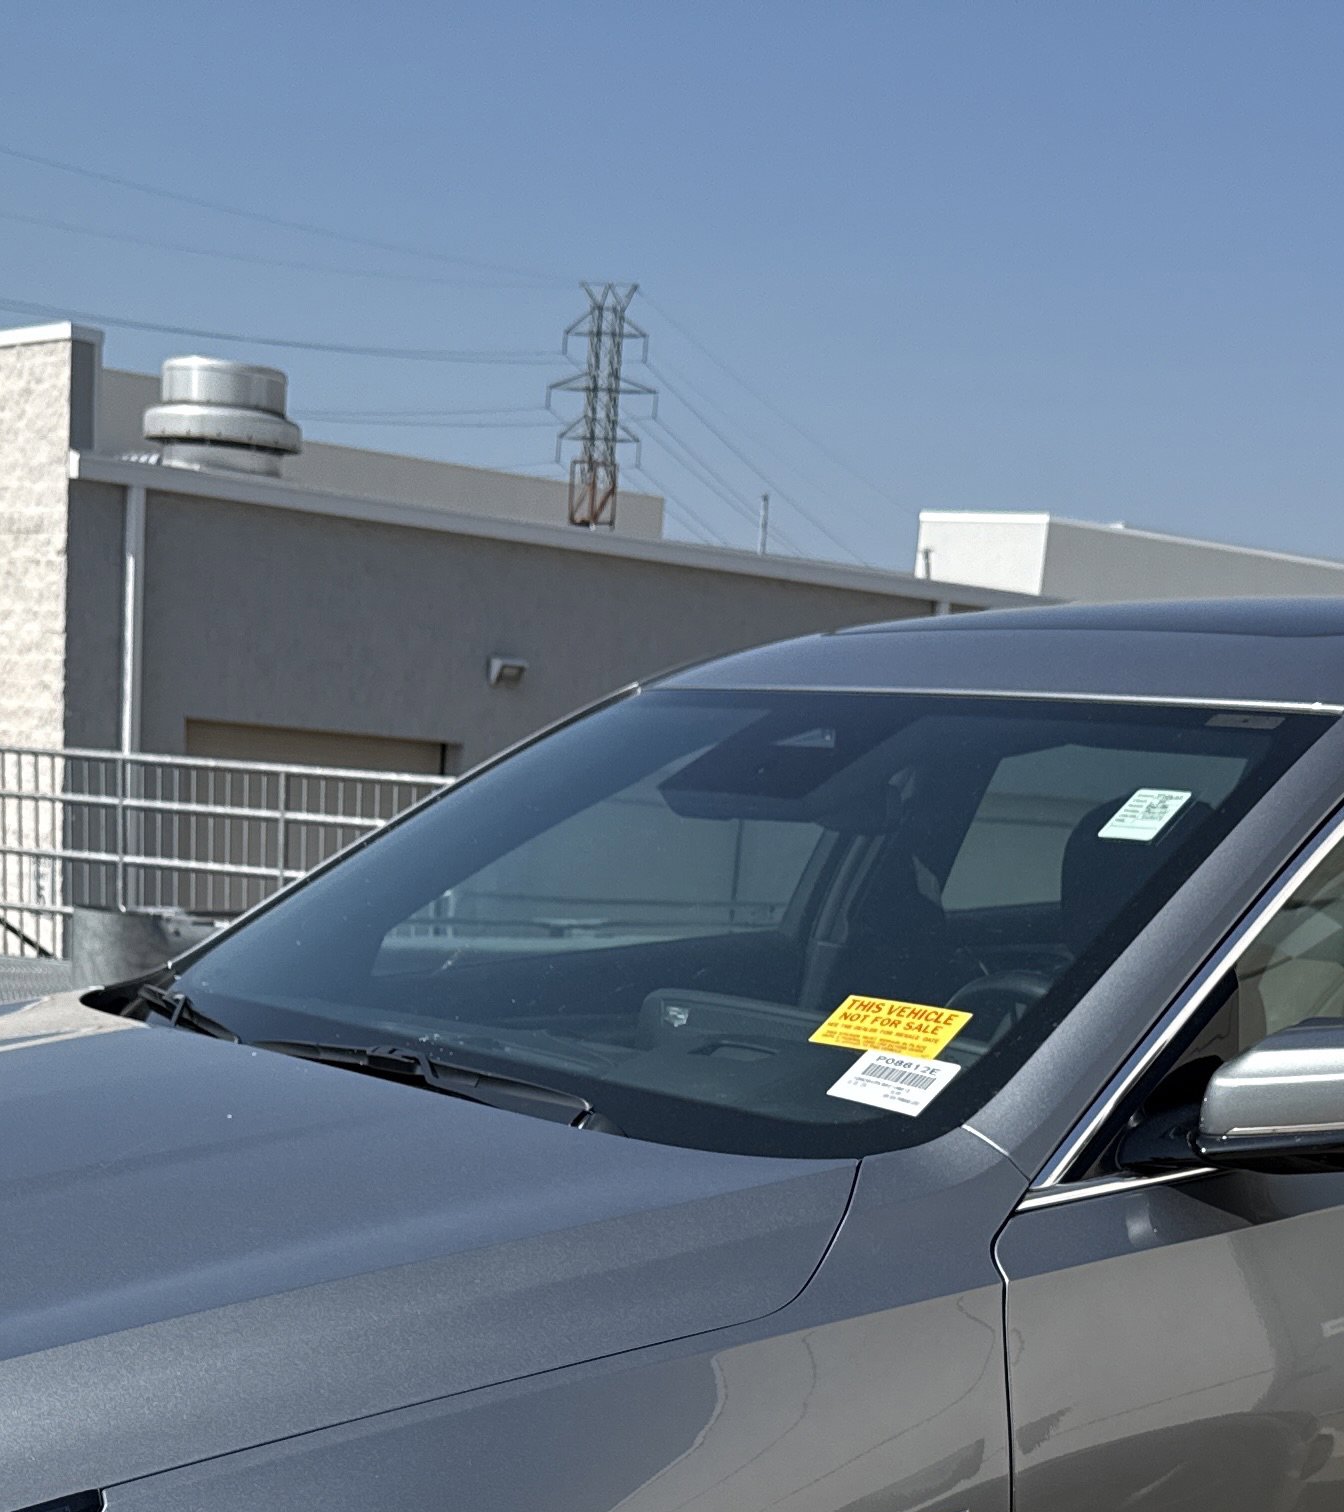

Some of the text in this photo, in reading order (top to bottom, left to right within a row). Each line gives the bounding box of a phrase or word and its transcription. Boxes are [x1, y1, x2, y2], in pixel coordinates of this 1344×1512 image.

[839, 1011, 944, 1035] NOT FOR SALE
[847, 998, 959, 1026] THIS VEHICLE
